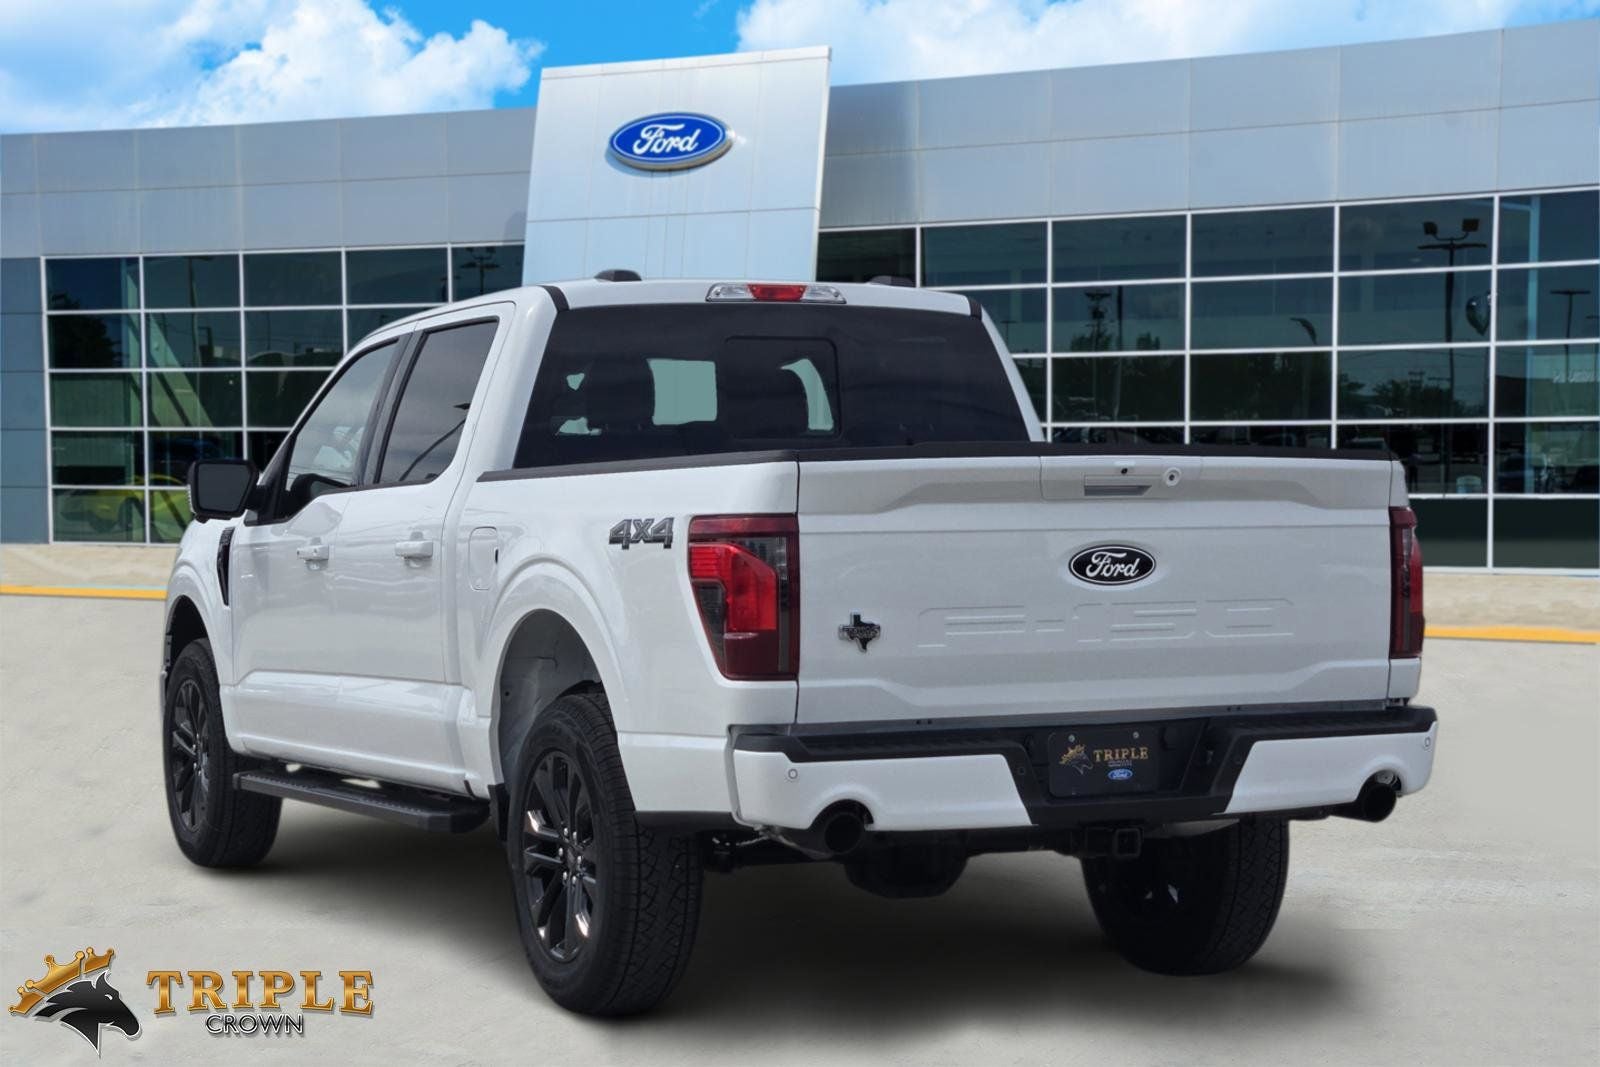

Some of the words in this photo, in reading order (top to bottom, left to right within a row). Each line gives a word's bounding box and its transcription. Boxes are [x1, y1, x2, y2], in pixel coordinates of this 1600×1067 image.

[632, 123, 701, 154] Ford
[1085, 551, 1140, 577] Ford
[917, 598, 1295, 647] F-150
[1093, 747, 1149, 762] TRIPLE
